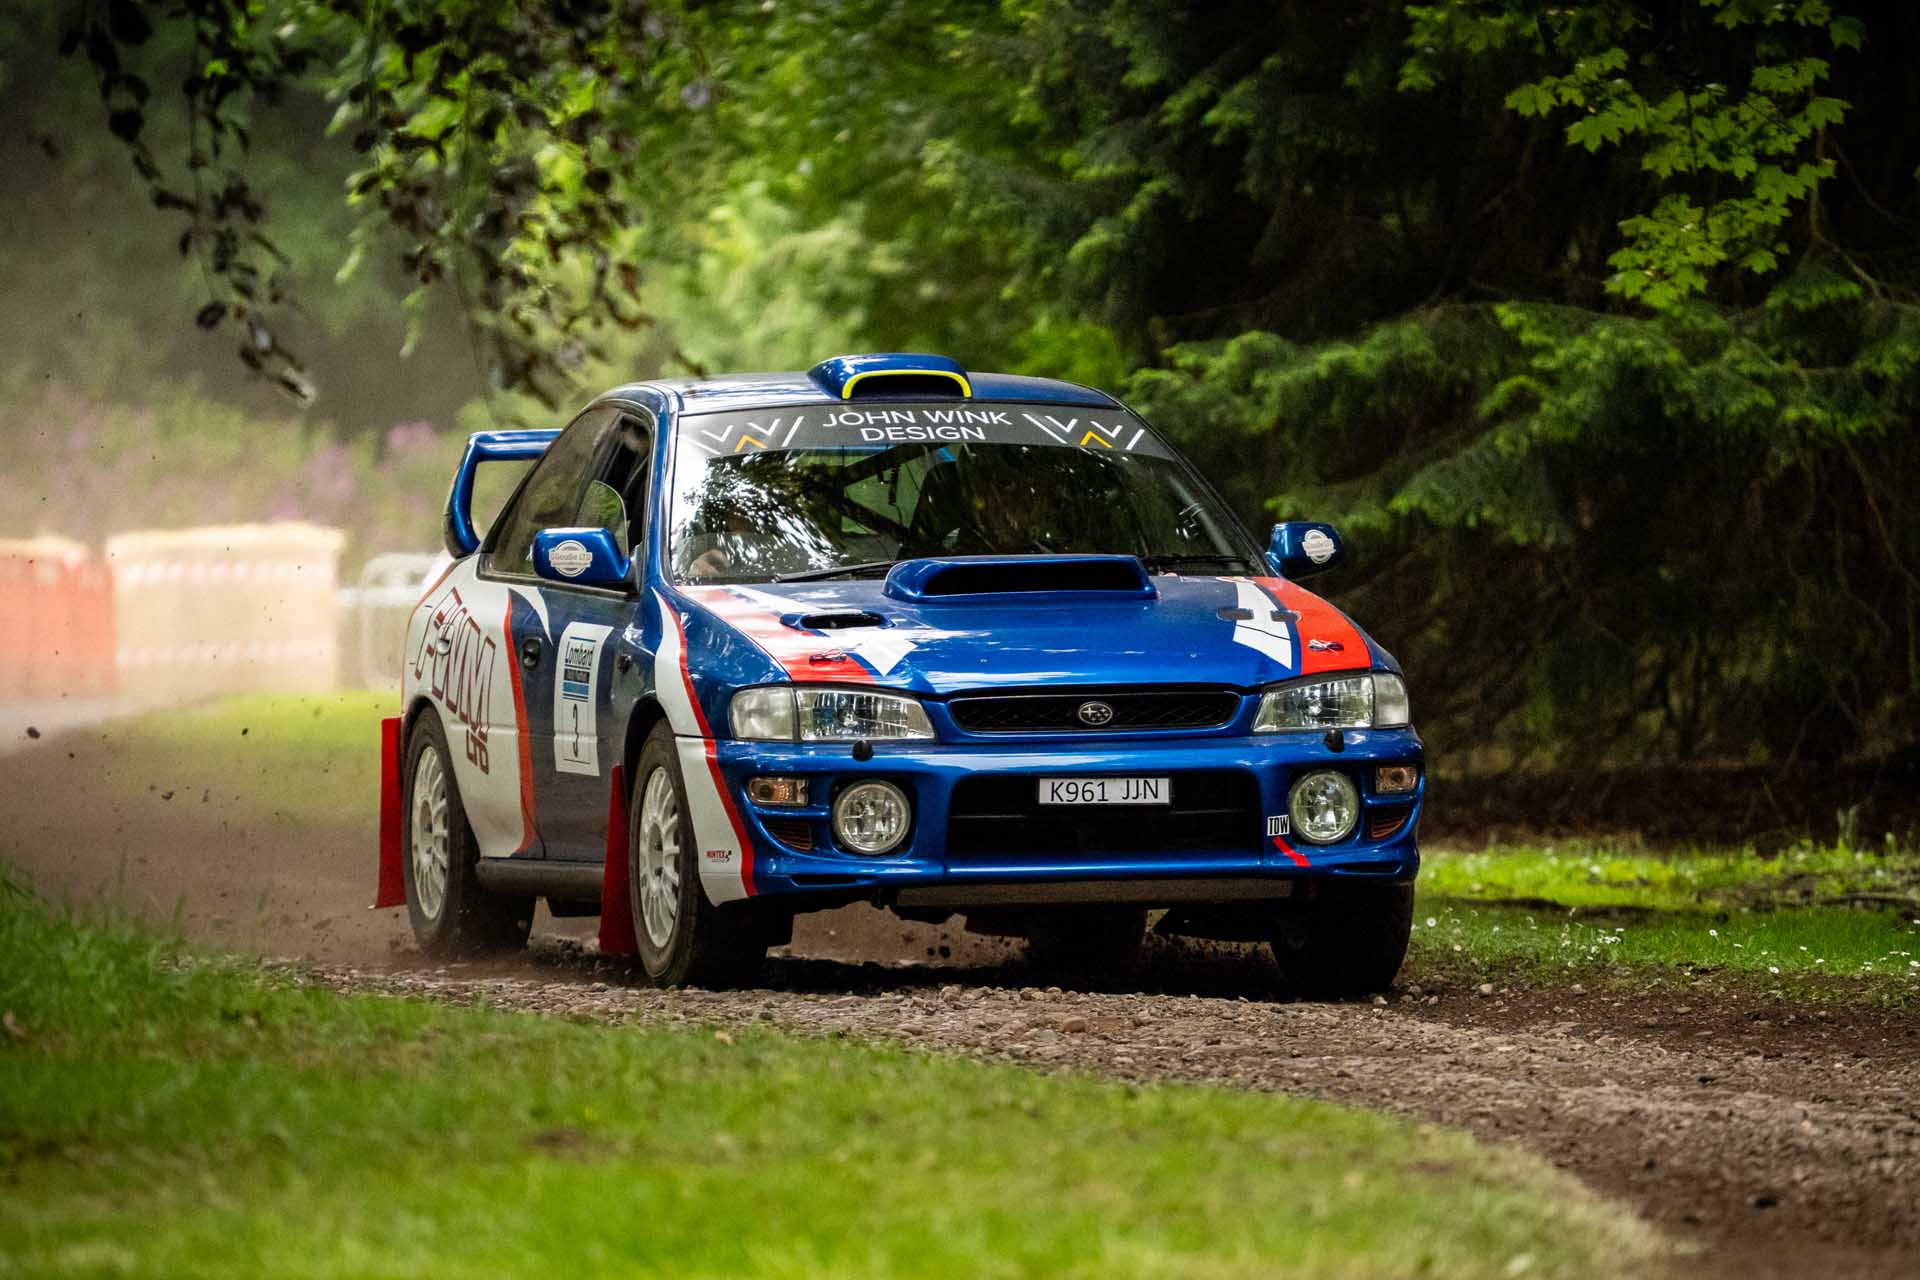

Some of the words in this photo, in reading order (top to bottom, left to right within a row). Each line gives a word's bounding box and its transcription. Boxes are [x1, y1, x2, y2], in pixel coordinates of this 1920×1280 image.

[822, 411, 916, 427] JOHN
[922, 410, 1012, 425] WINK
[860, 426, 986, 441] DESIGN
[466, 728, 489, 775] LTD
[1050, 781, 1109, 802] K961
[1121, 779, 1159, 800] JJN
[1268, 816, 1289, 835] TOW
